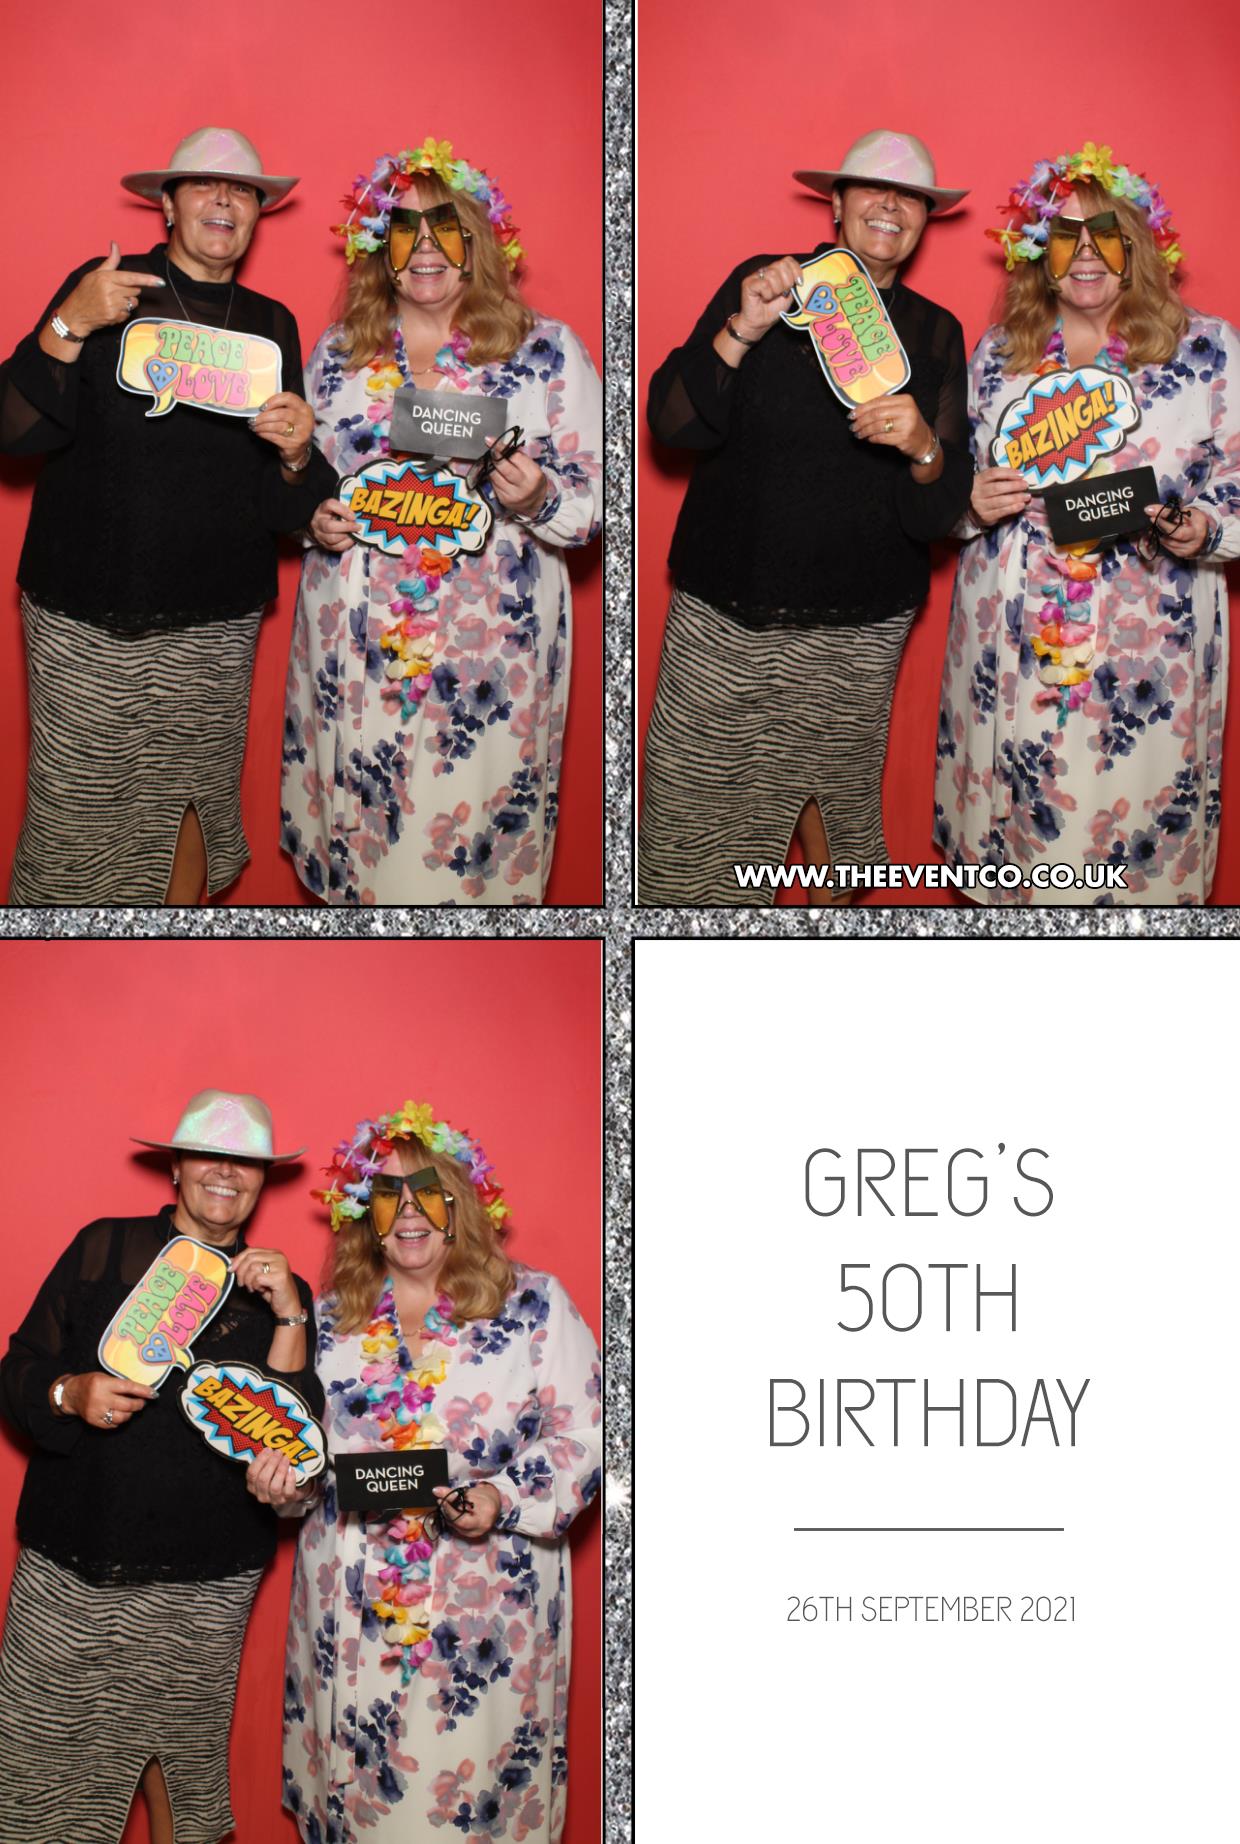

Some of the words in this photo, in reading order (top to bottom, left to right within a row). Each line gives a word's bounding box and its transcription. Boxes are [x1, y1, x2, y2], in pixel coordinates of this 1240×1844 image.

[835, 275, 896, 361] PEACE
[159, 326, 245, 370] PEACE
[813, 312, 869, 382] LOVE
[174, 364, 248, 405] LOVE
[412, 405, 482, 425] DANCING
[421, 421, 473, 438] QUEEN
[1005, 381, 1115, 469] BAZINGA!
[350, 487, 481, 531] BAZINGA!
[1065, 486, 1134, 511] DANCING
[1078, 501, 1130, 522] QUEEN
[118, 1262, 187, 1344] PEACE
[158, 1274, 218, 1346] LOVE
[192, 1375, 318, 1466] BAZINGA!
[355, 1465, 425, 1480] DANCING
[366, 1479, 418, 1493] QUEEN
